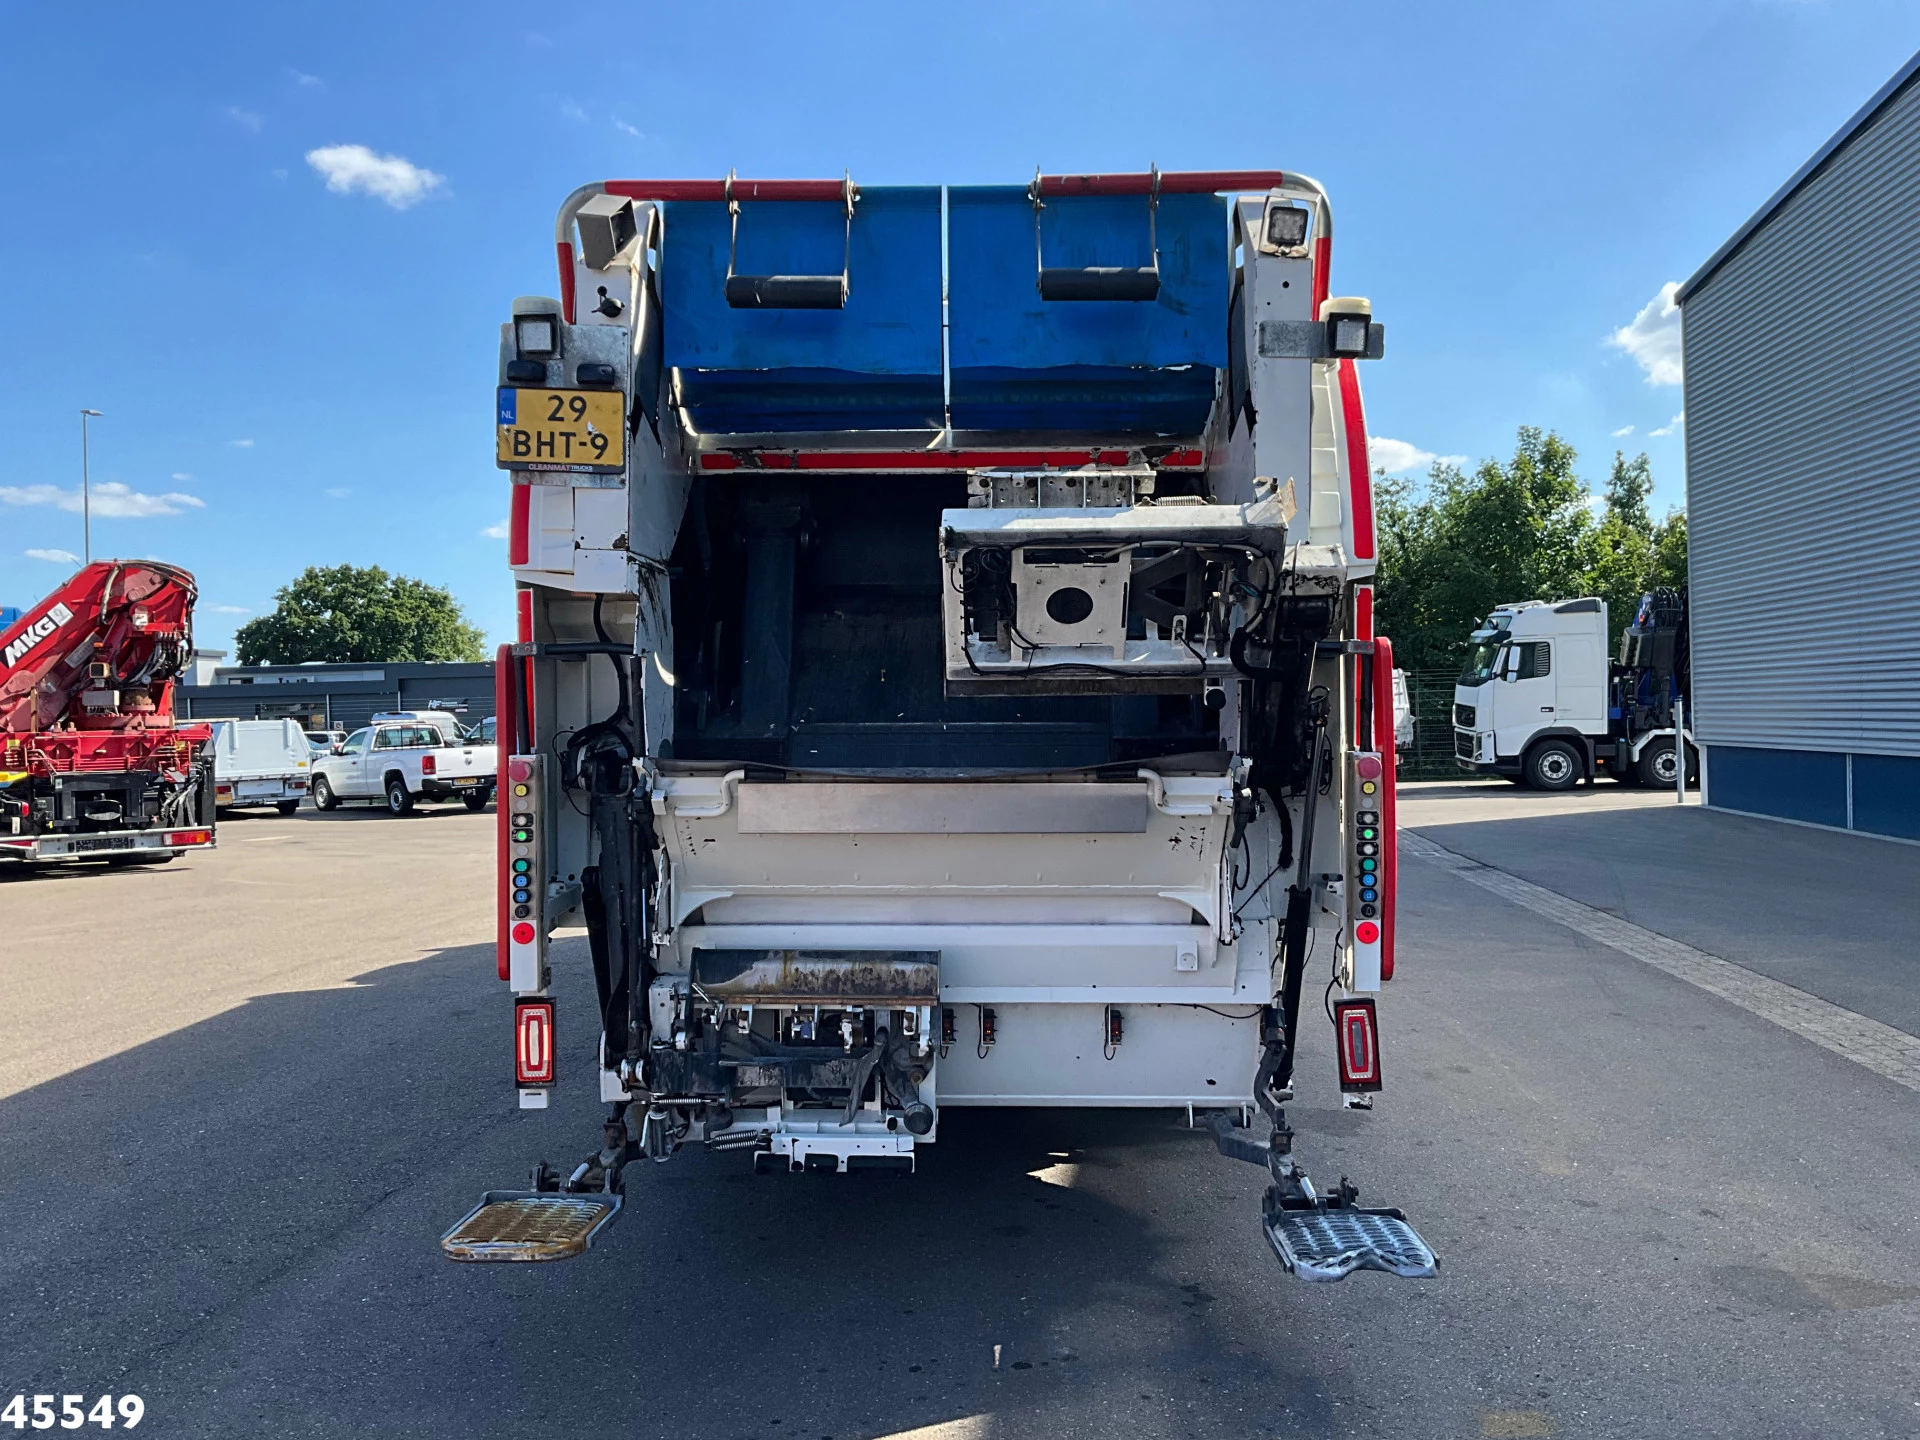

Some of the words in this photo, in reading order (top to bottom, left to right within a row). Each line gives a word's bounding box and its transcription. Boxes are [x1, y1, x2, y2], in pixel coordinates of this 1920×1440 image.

[501, 410, 514, 419] NL
[547, 394, 587, 422] 29
[513, 430, 609, 460] BHT-9
[528, 463, 571, 471] CLEANMAT
[4, 616, 57, 668] MKG
